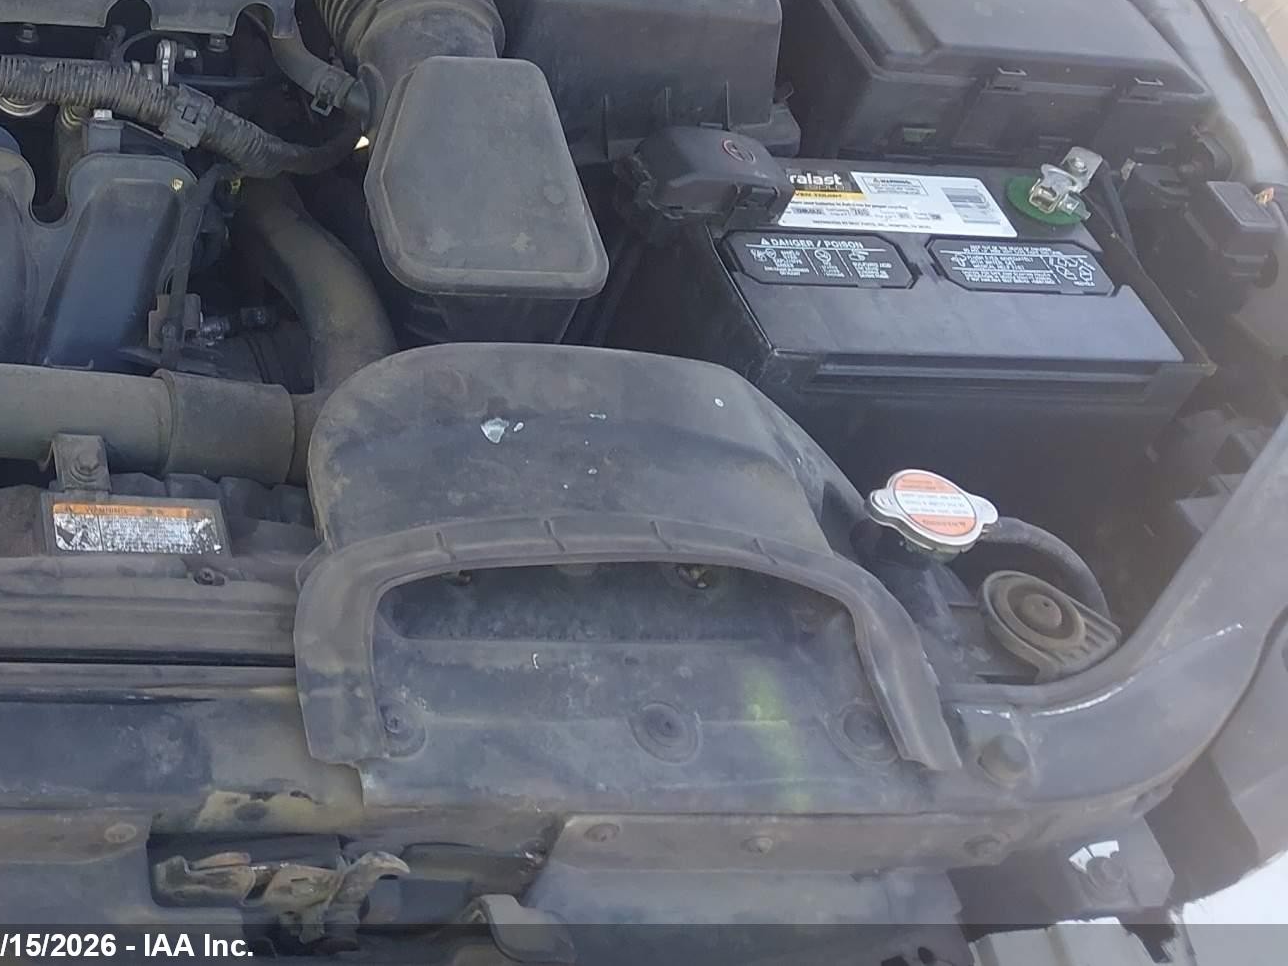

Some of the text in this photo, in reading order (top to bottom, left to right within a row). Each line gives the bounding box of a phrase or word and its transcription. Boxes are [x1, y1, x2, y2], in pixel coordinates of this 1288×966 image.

[787, 172, 843, 185] ralast
[770, 238, 815, 247] DANGER
[823, 240, 864, 250] POISON
